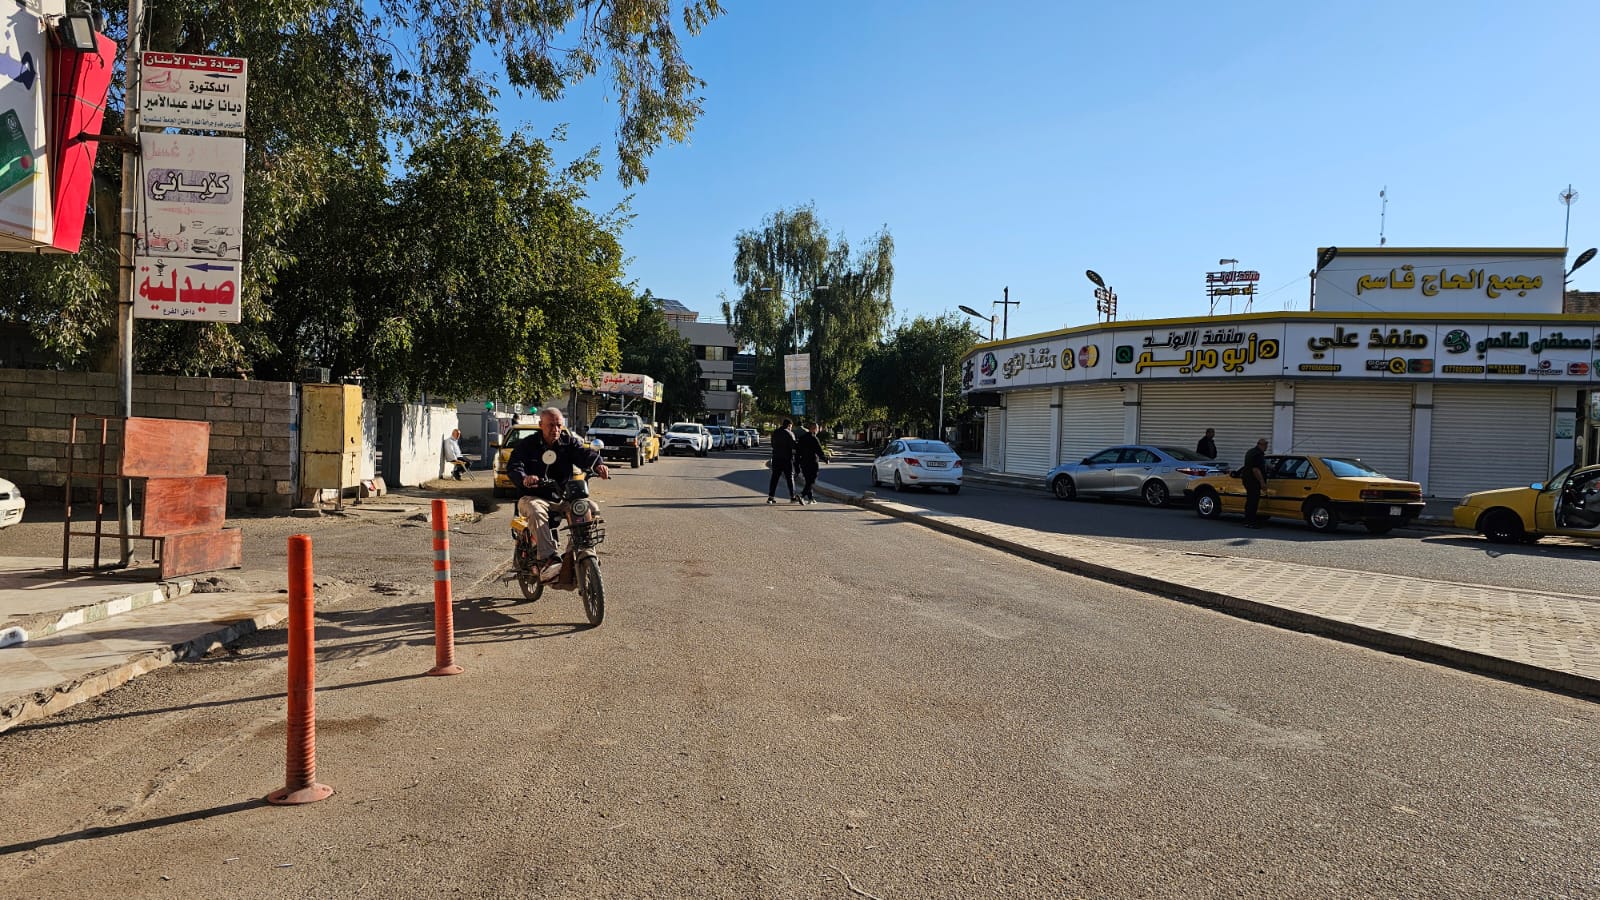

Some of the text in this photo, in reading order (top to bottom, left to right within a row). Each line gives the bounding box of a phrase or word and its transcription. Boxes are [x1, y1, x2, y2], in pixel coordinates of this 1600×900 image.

[188, 58, 208, 68] طب
[210, 59, 240, 72] عيادة
[189, 80, 230, 94] الدكتورة
[192, 98, 214, 110] خالد
[218, 100, 242, 116] ديانا
[138, 266, 235, 312] صيدلية
[1356, 264, 1543, 298] مجمع الحاج قاسم
[162, 306, 196, 316] داخل الفرع
[1143, 328, 1245, 350] منفذ الوند
[1308, 327, 1428, 360] منفذ علي
[1530, 332, 1591, 354] مصطفى
[1136, 333, 1258, 374] أبو مريم
